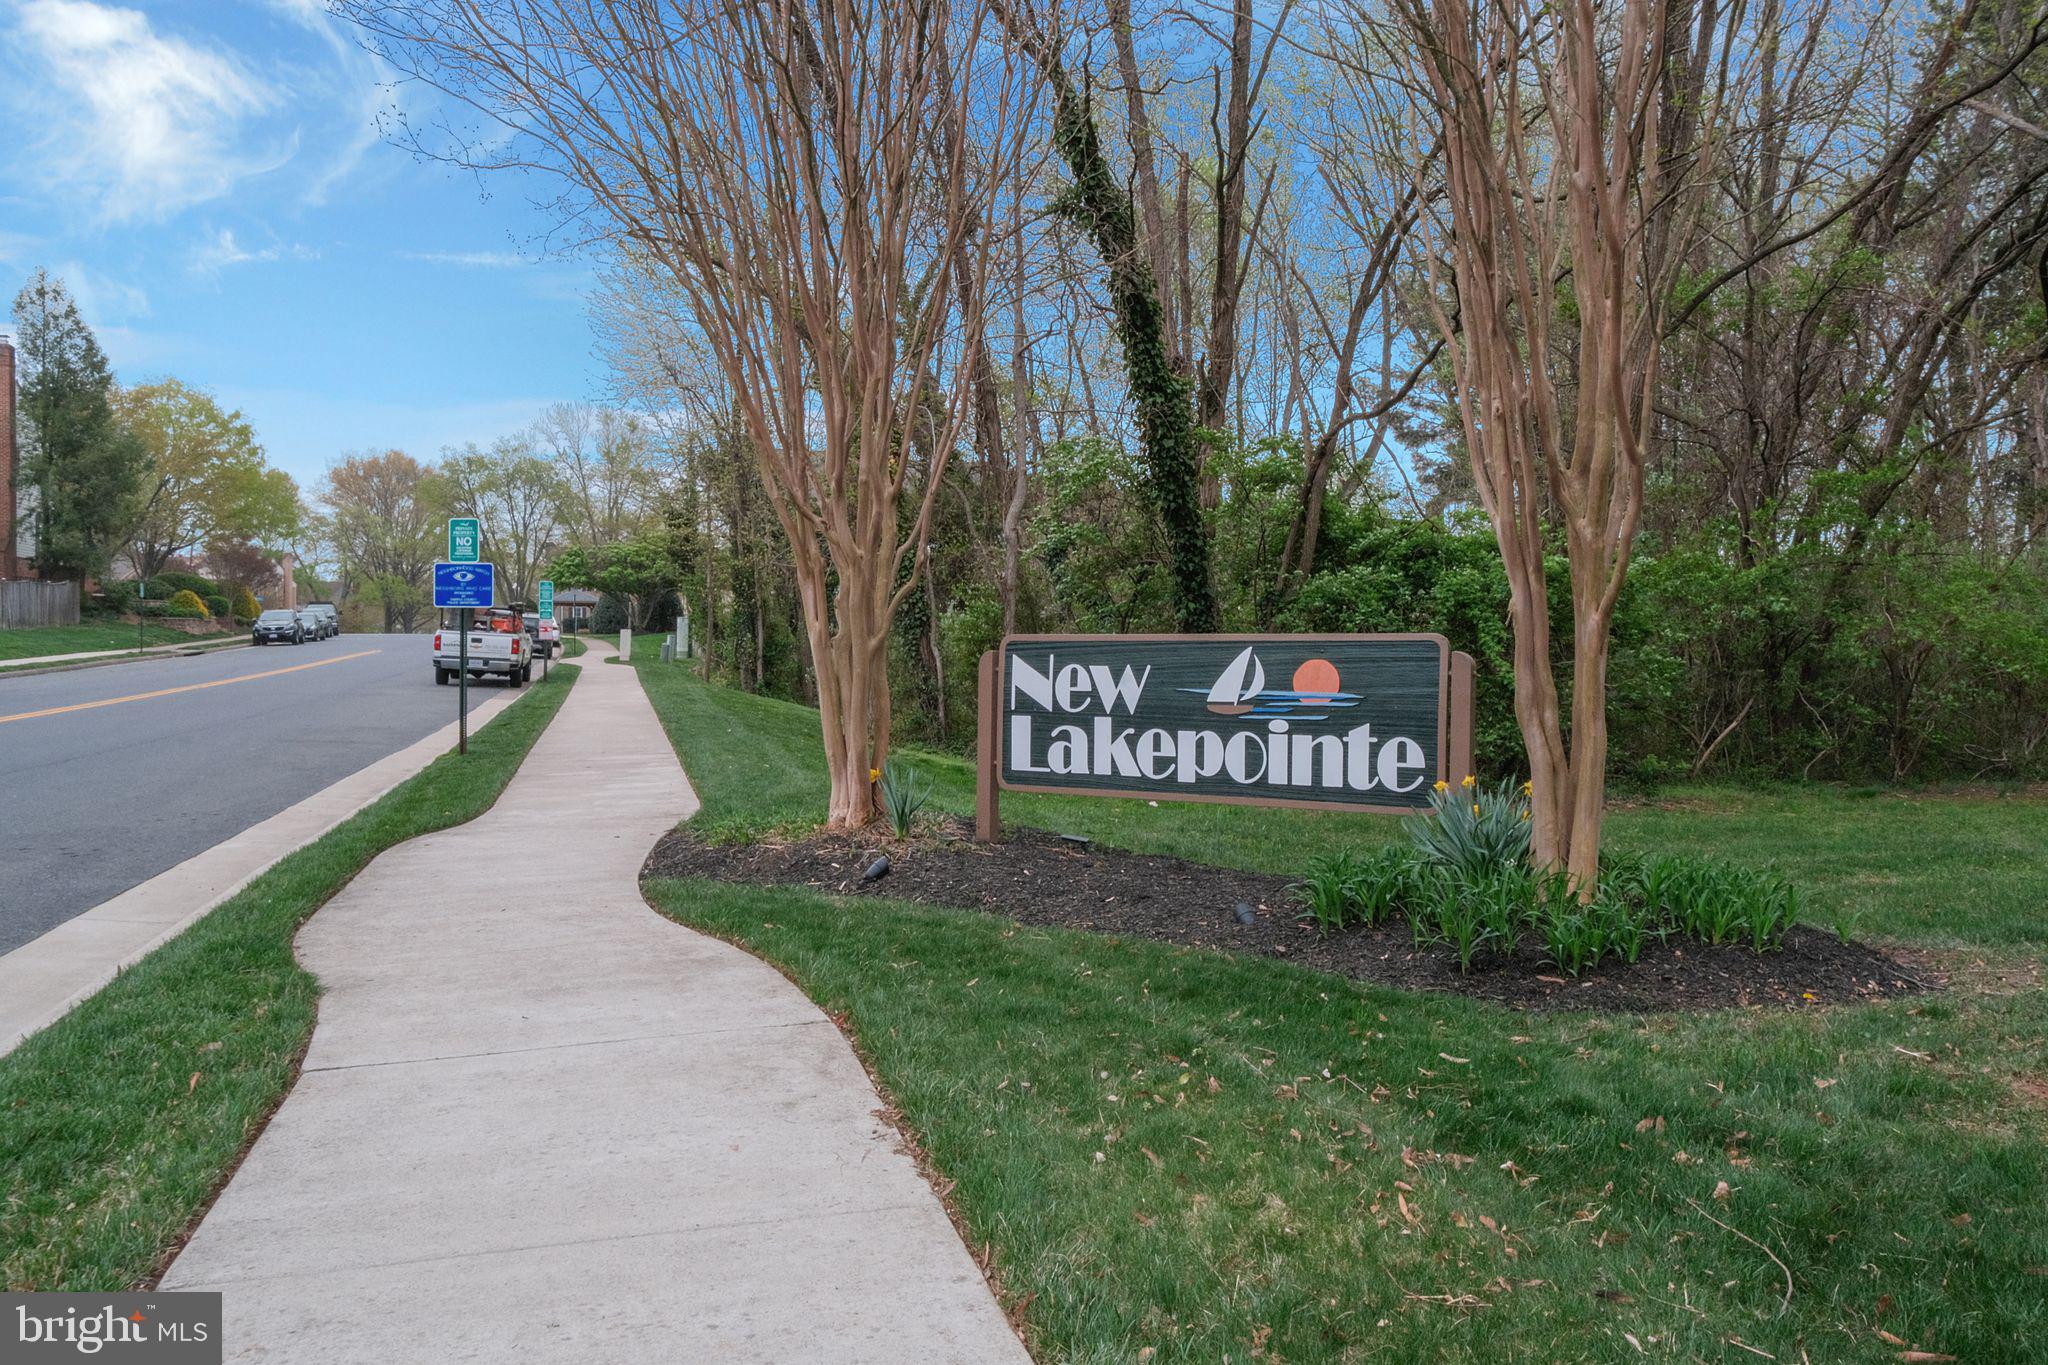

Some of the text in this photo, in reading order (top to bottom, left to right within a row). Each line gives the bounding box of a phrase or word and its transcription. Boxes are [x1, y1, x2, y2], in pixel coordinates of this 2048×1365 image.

[456, 537, 472, 546] NO
[1010, 653, 1151, 715] New
[1010, 715, 1426, 793] Lakepointe
